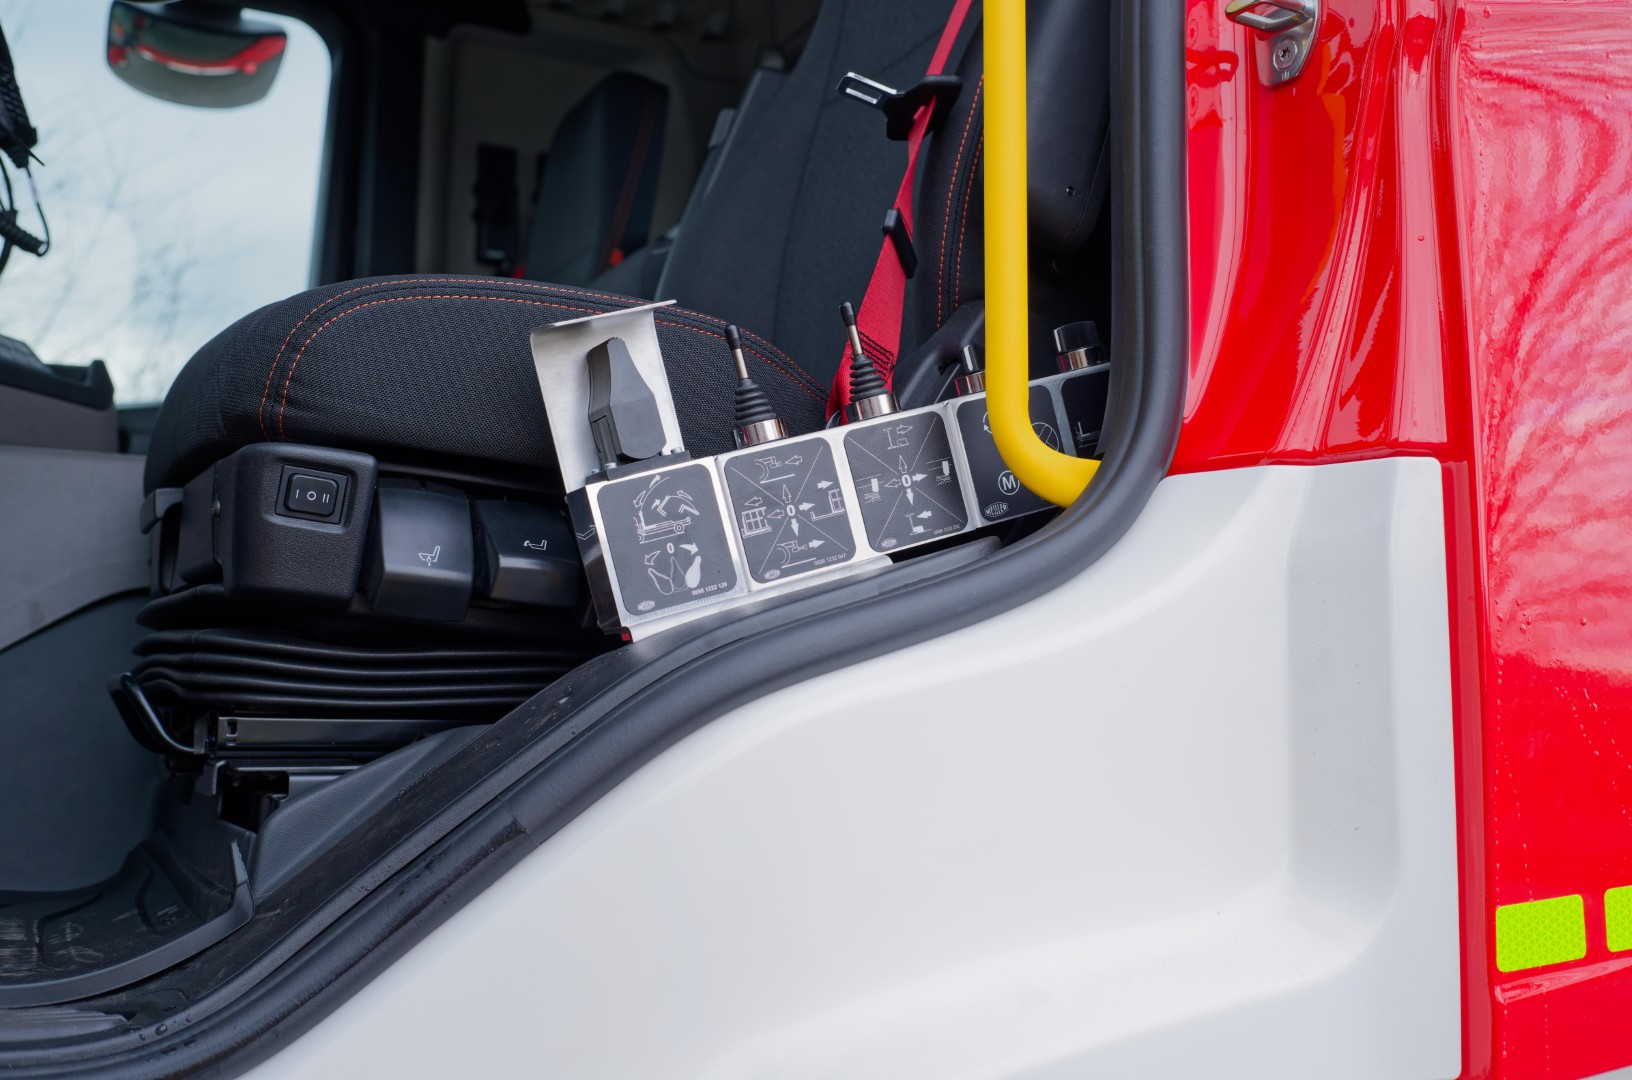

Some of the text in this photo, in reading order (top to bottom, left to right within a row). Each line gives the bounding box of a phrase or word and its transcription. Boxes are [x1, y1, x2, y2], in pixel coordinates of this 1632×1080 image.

[901, 474, 911, 487] 0
[1002, 475, 1016, 491] M
[786, 504, 796, 517] 0
[666, 542, 675, 554] 0
